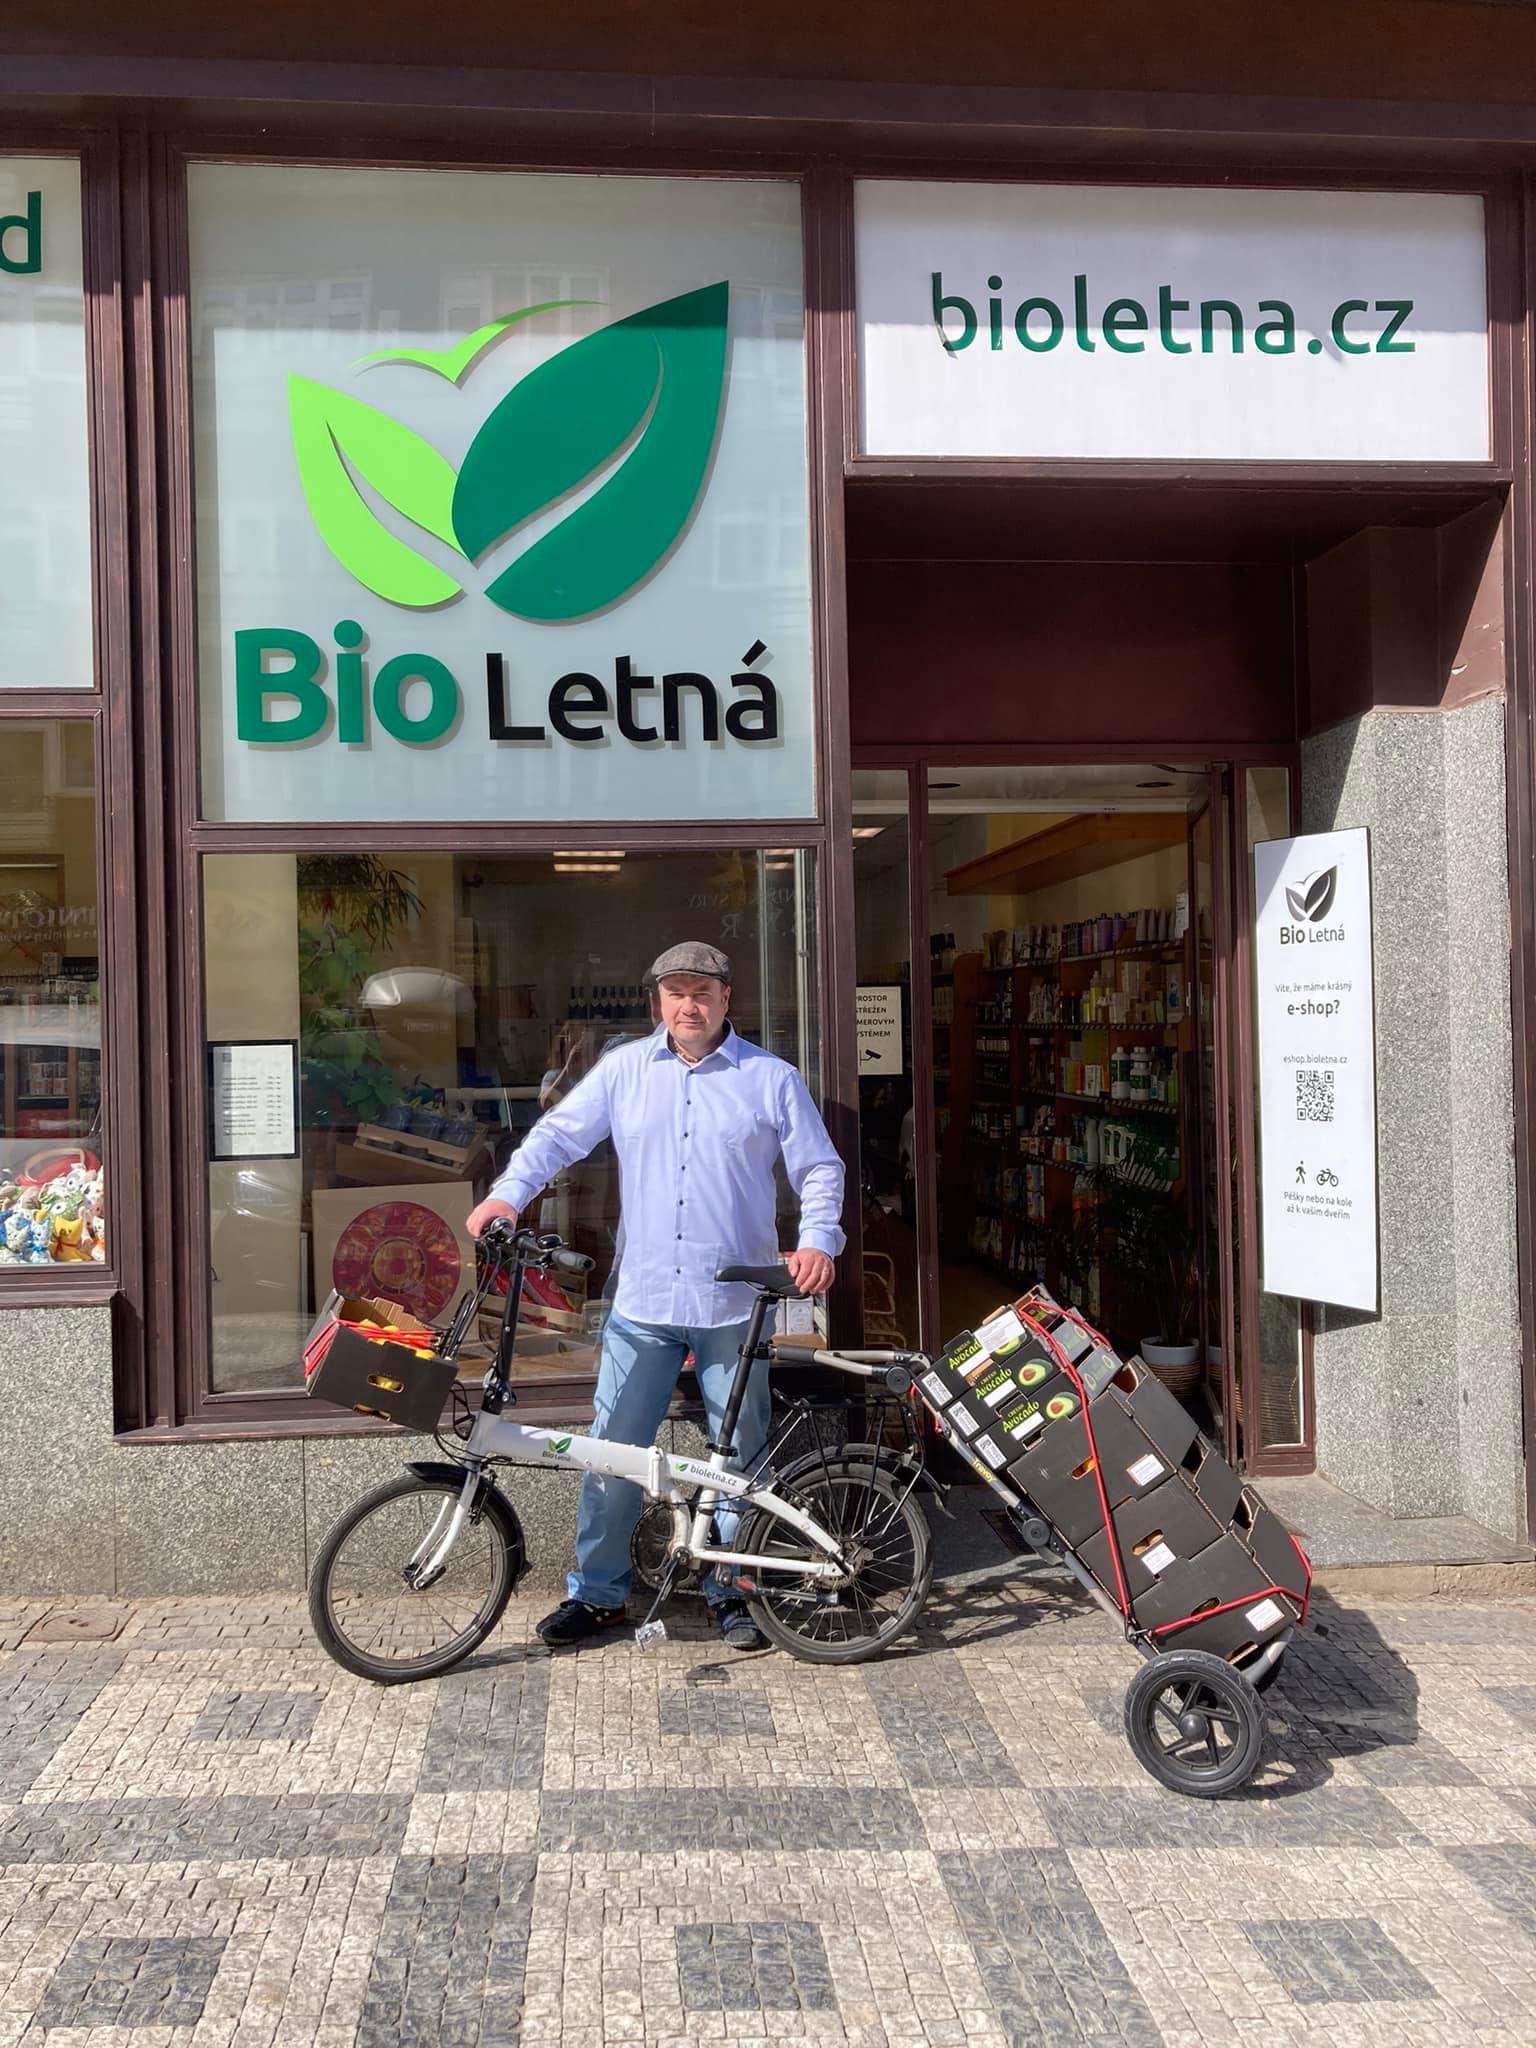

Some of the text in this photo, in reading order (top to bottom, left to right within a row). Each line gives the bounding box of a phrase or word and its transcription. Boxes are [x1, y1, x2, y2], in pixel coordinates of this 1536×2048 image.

[931, 272, 1415, 354] bioletna.cz
[234, 620, 779, 744] Bio Letná
[1280, 923, 1345, 944] Bio Letná
[1303, 982, 1326, 992] máme
[1328, 980, 1353, 993] krásný
[856, 994, 888, 1002] ROSTOR
[1287, 999, 1341, 1018] e-shop?
[1283, 1054, 1348, 1065] eshop.bioletna.cz
[1305, 1195, 1325, 1204] nebo
[1326, 1197, 1336, 1205] na
[1336, 1197, 1353, 1207] kole
[948, 1338, 981, 1369] Avocad
[975, 1368, 1012, 1400] Avocado
[1002, 1400, 1040, 1433] Avocado
[690, 1465, 738, 1487] bioletna.cz
